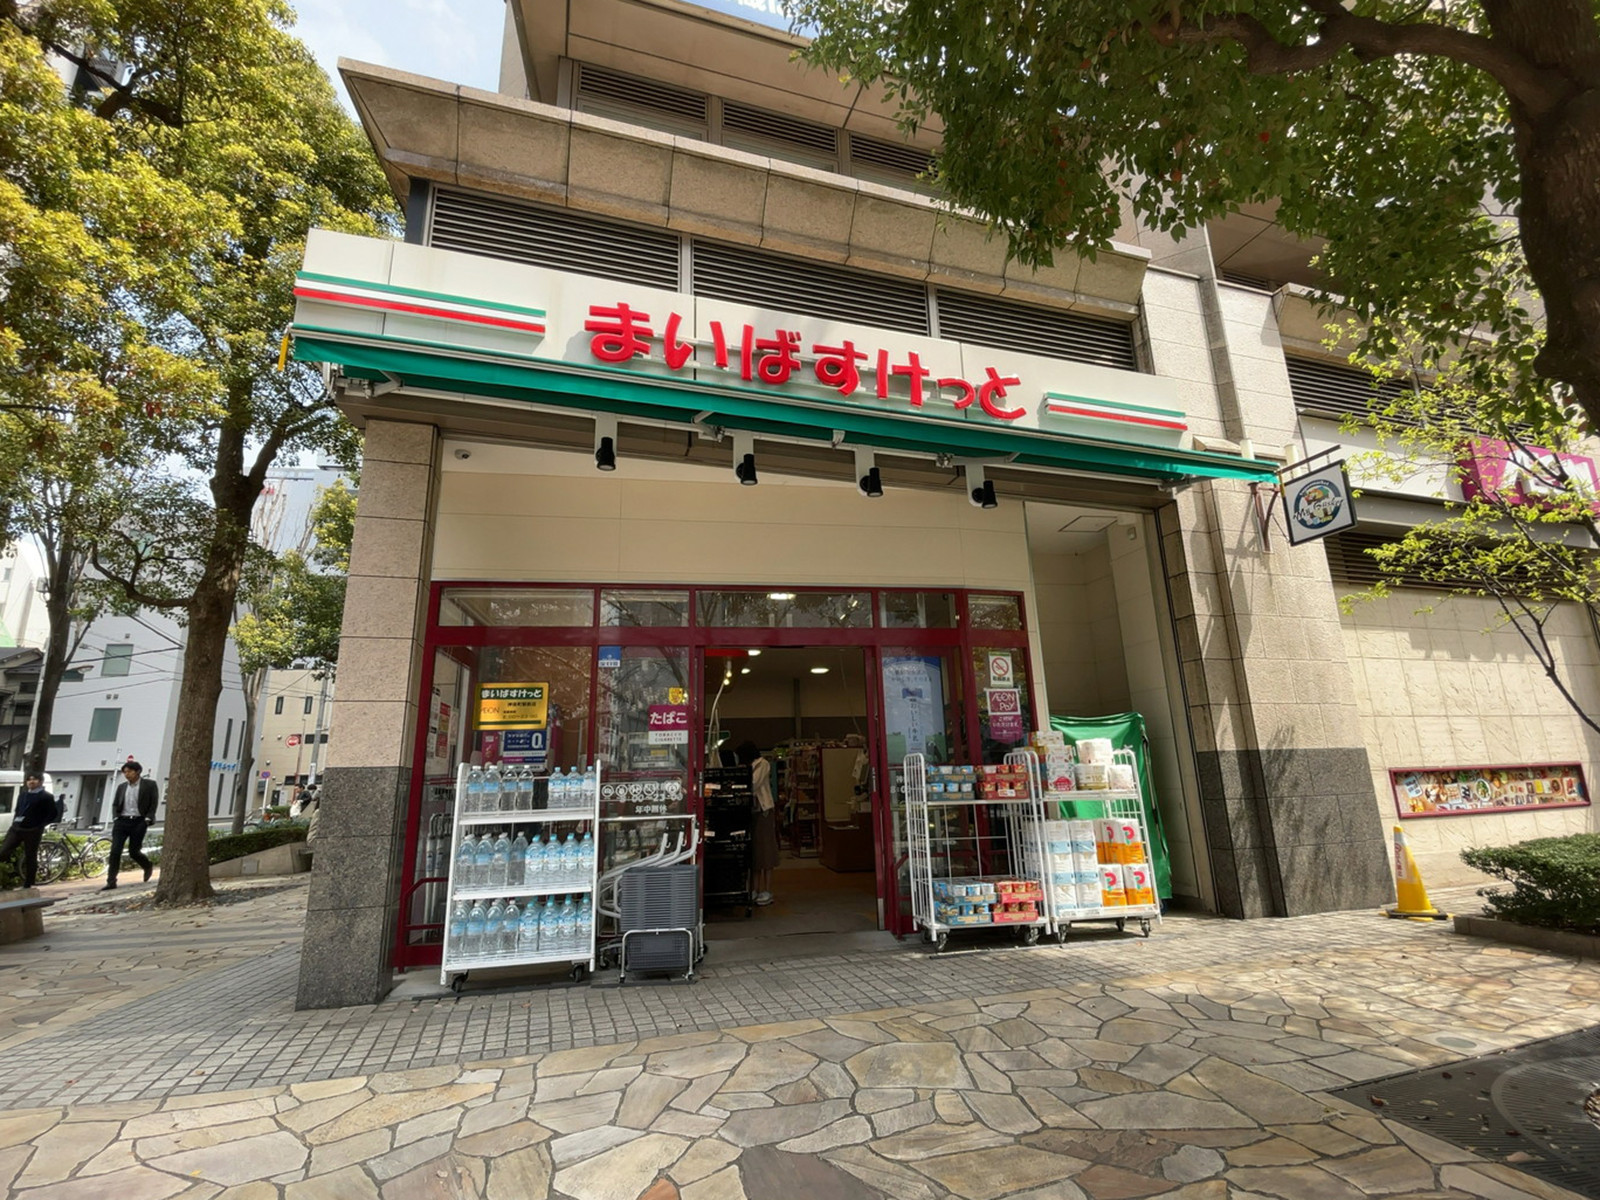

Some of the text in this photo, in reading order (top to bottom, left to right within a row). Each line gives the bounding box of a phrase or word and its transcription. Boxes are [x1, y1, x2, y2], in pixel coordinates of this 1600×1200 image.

[585, 302, 1027, 421] まいばすけっと
[481, 689, 542, 699] まいばすけっと
[649, 711, 687, 725] たばこ
